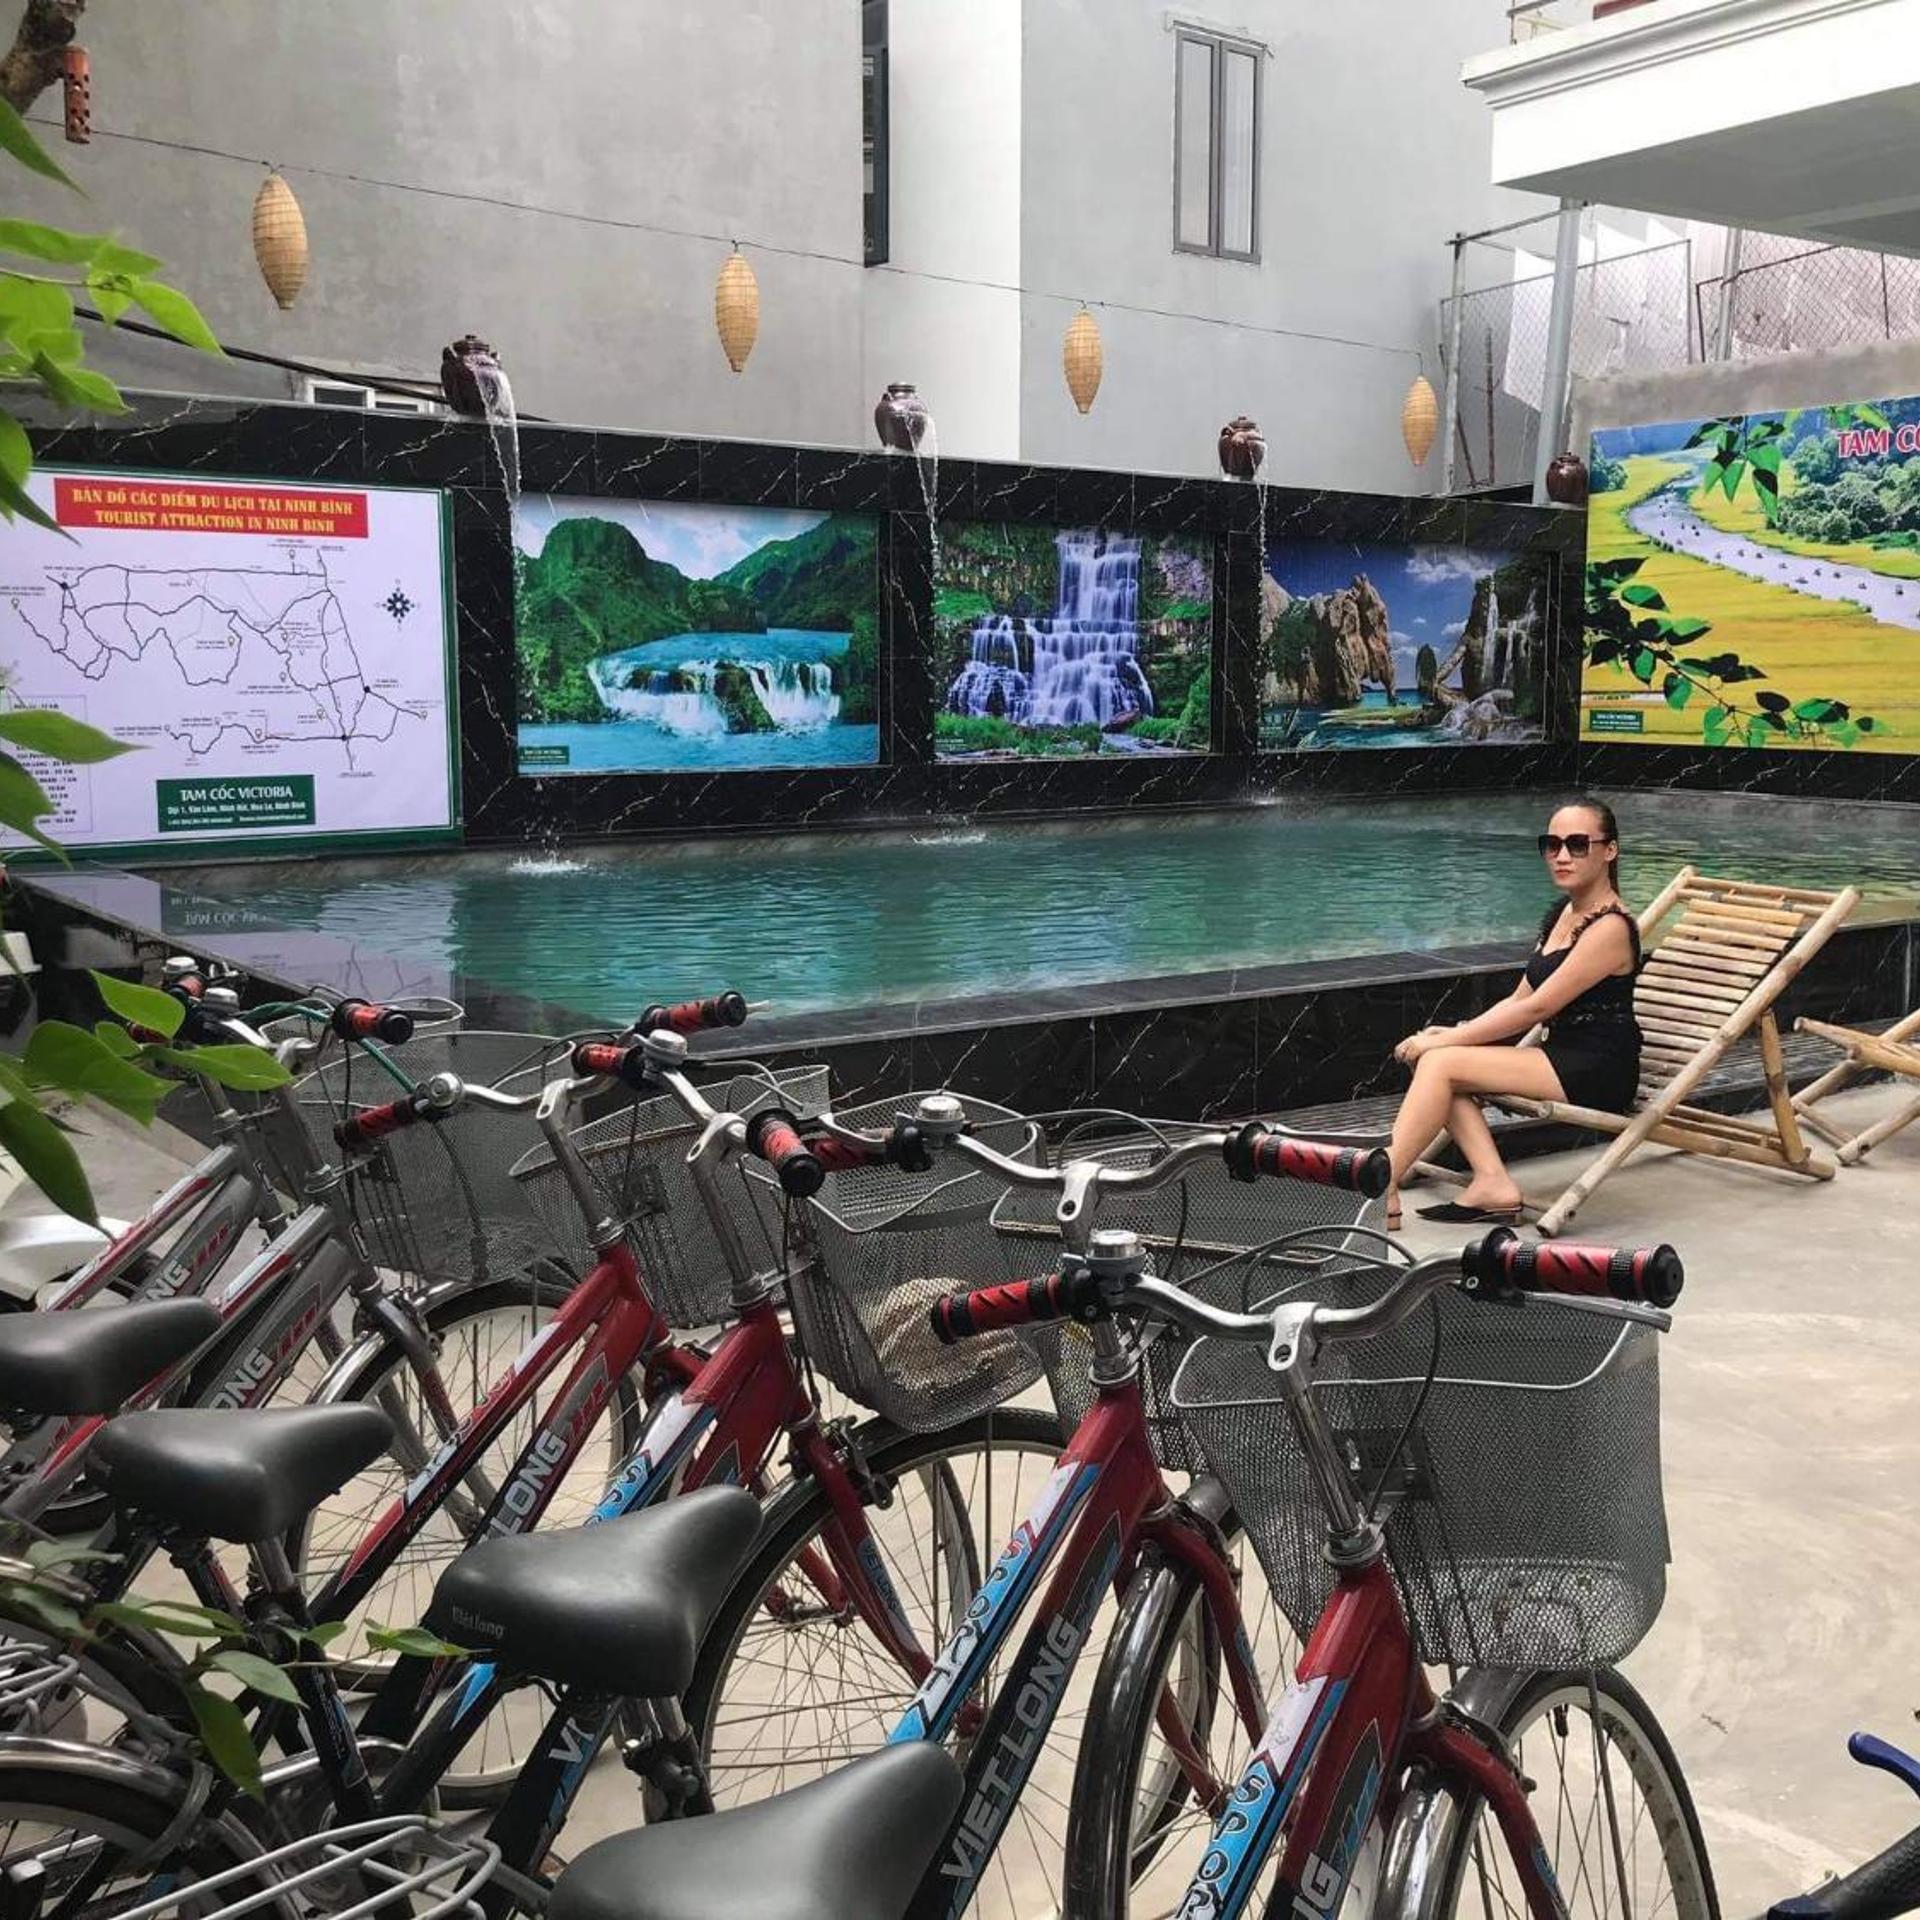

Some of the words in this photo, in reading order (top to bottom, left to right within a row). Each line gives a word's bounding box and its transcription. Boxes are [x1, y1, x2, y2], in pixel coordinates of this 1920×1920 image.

[1837, 428, 1890, 458] TAM
[285, 499, 317, 513] NINH
[95, 510, 156, 525] TOURIST
[160, 512, 244, 529] ATTRACTION
[247, 516, 262, 530] IN
[266, 517, 298, 531] NINH
[180, 789, 206, 801] TAM
[237, 786, 293, 799] VICTORIA
